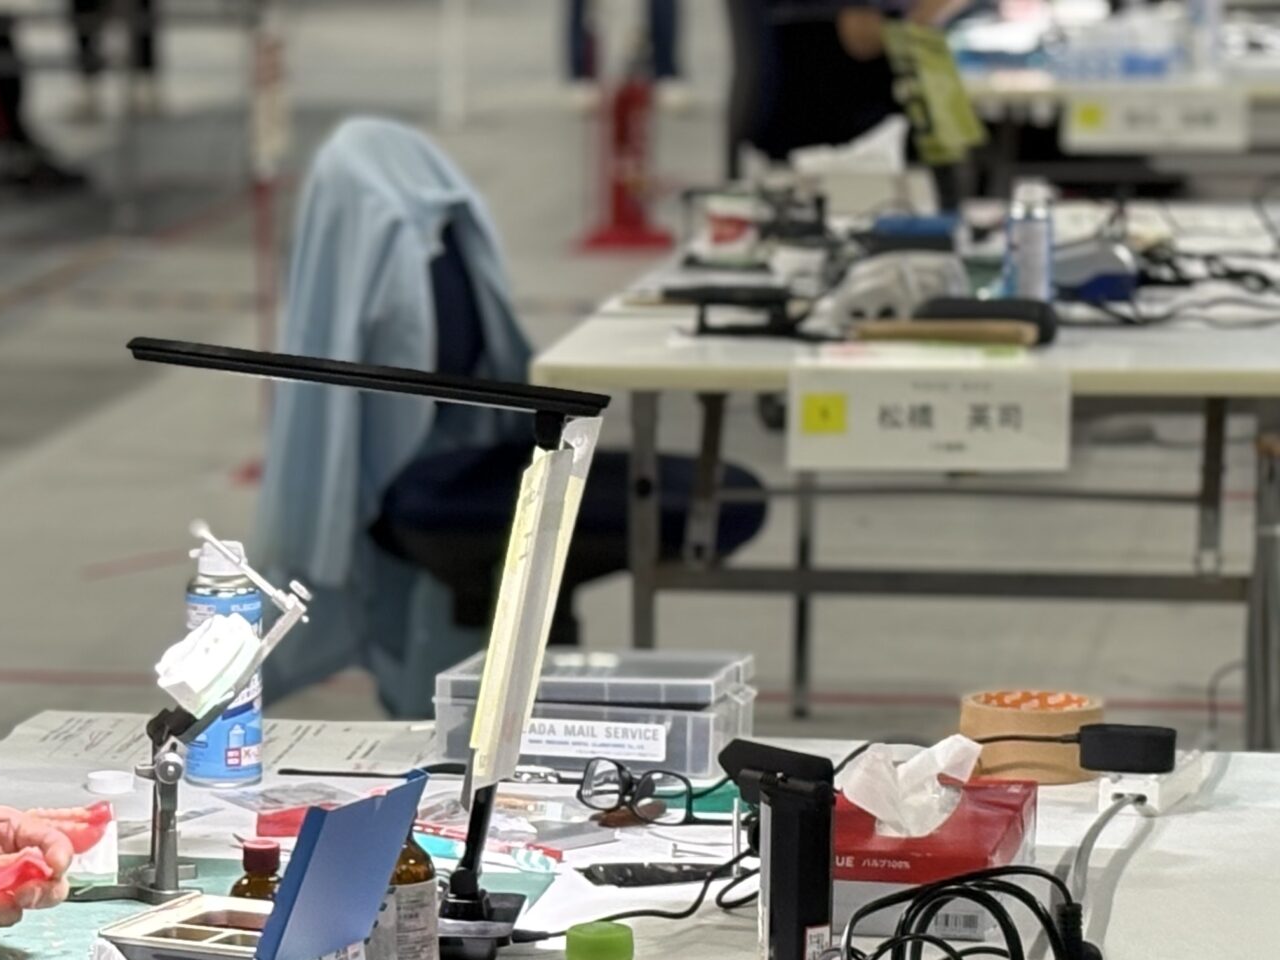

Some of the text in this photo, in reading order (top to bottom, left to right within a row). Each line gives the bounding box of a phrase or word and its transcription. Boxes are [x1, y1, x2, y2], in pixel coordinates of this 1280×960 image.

[522, 722, 658, 741] ADA MAIL SERVICE
